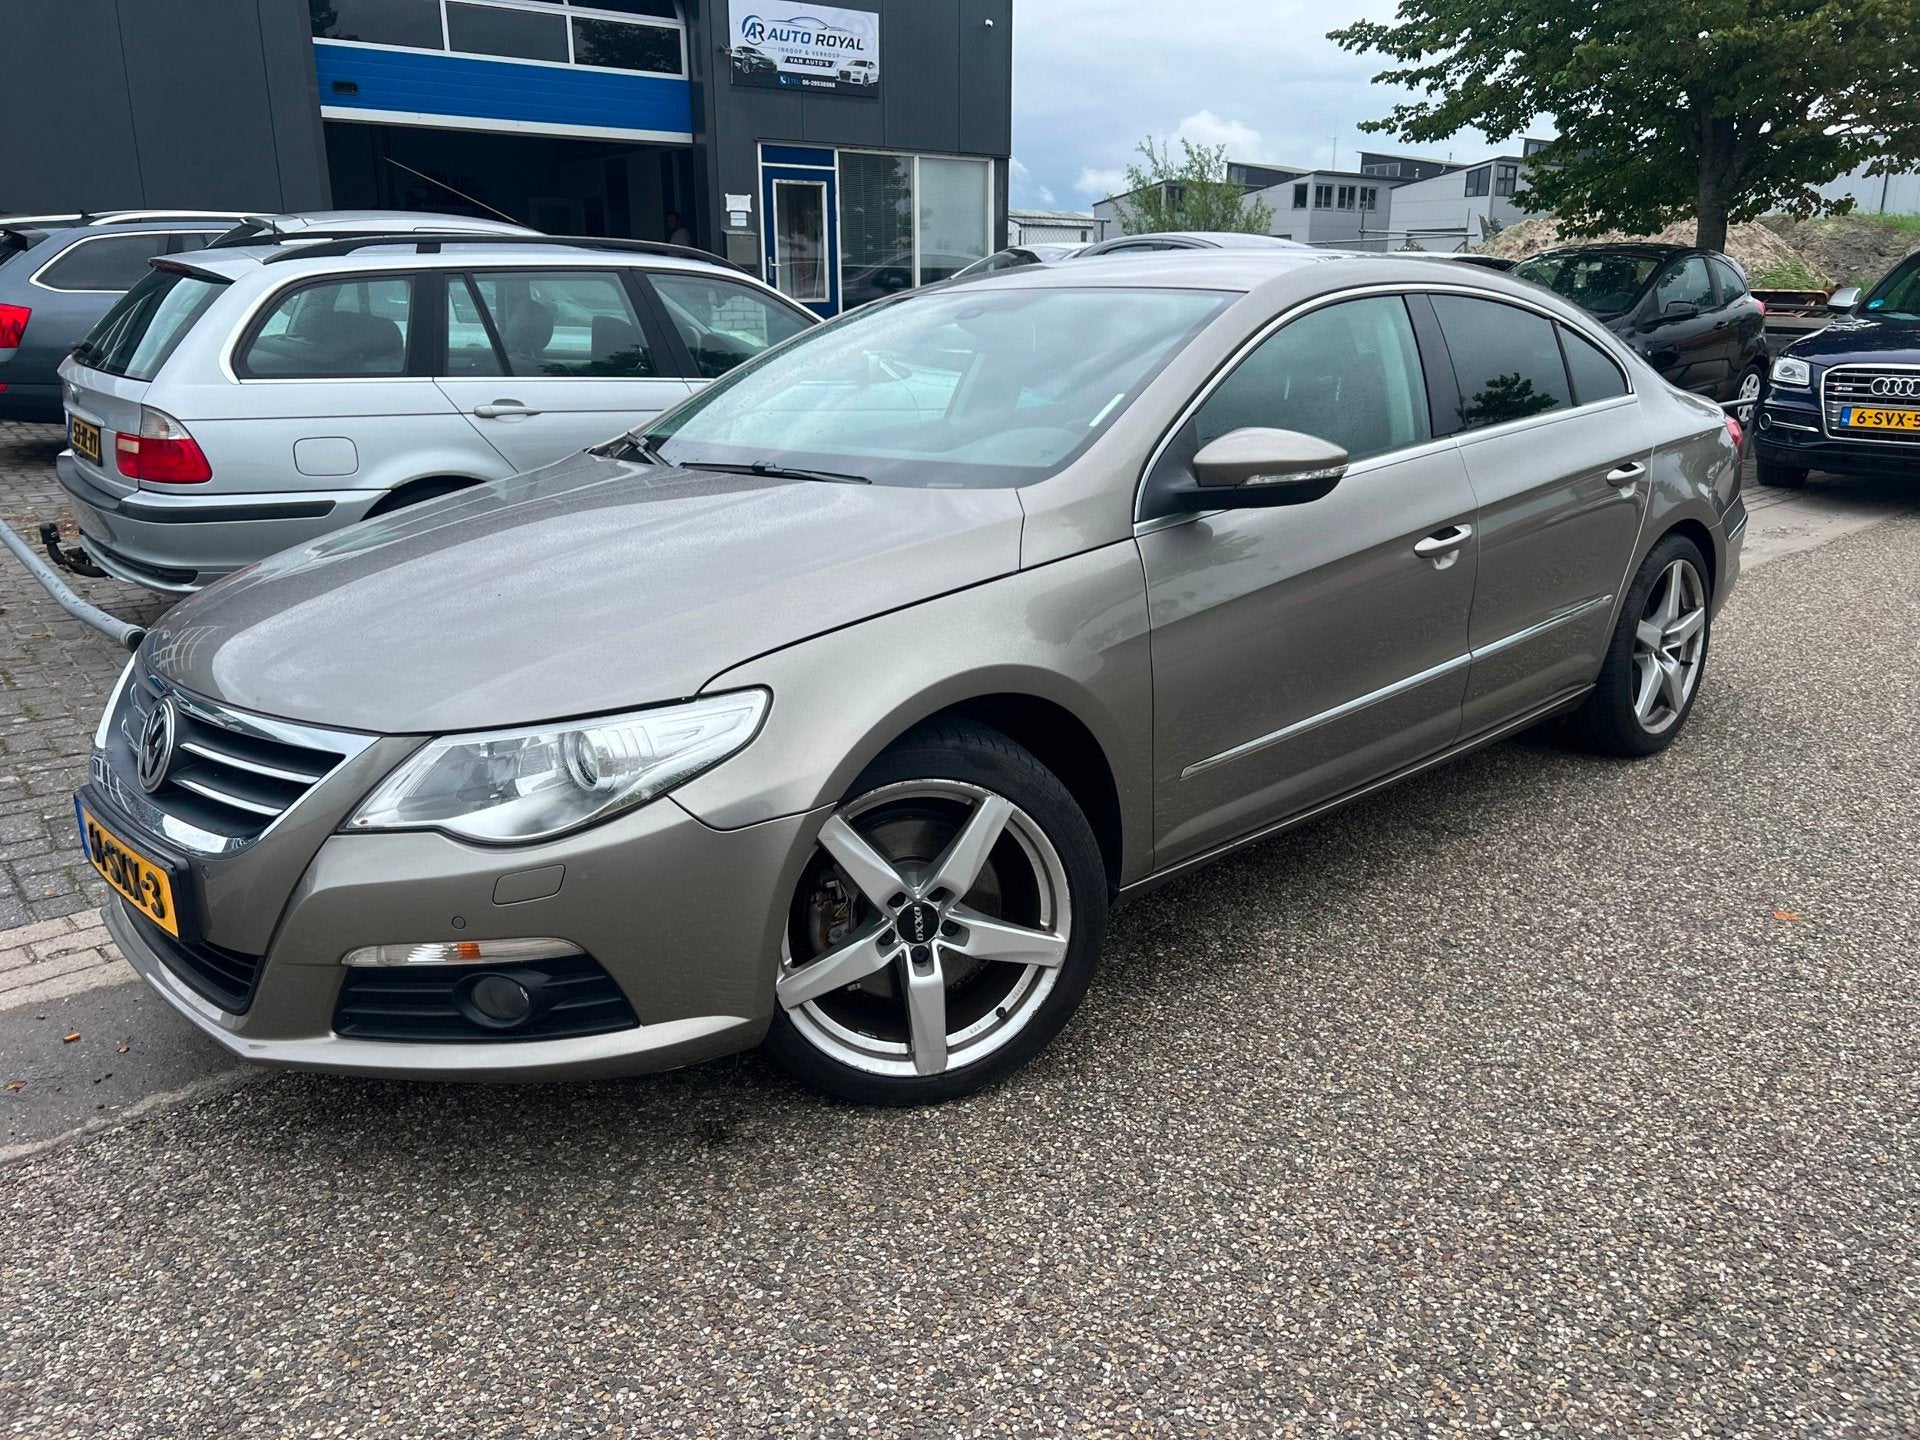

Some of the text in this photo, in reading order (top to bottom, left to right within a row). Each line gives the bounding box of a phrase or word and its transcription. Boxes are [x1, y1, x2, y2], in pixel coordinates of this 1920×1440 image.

[767, 28, 865, 51] AUTO ROYAL
[811, 51, 840, 59] VERKOOP
[805, 59, 830, 67] AUTO'S
[1856, 411, 1920, 428] 6-SVX-5
